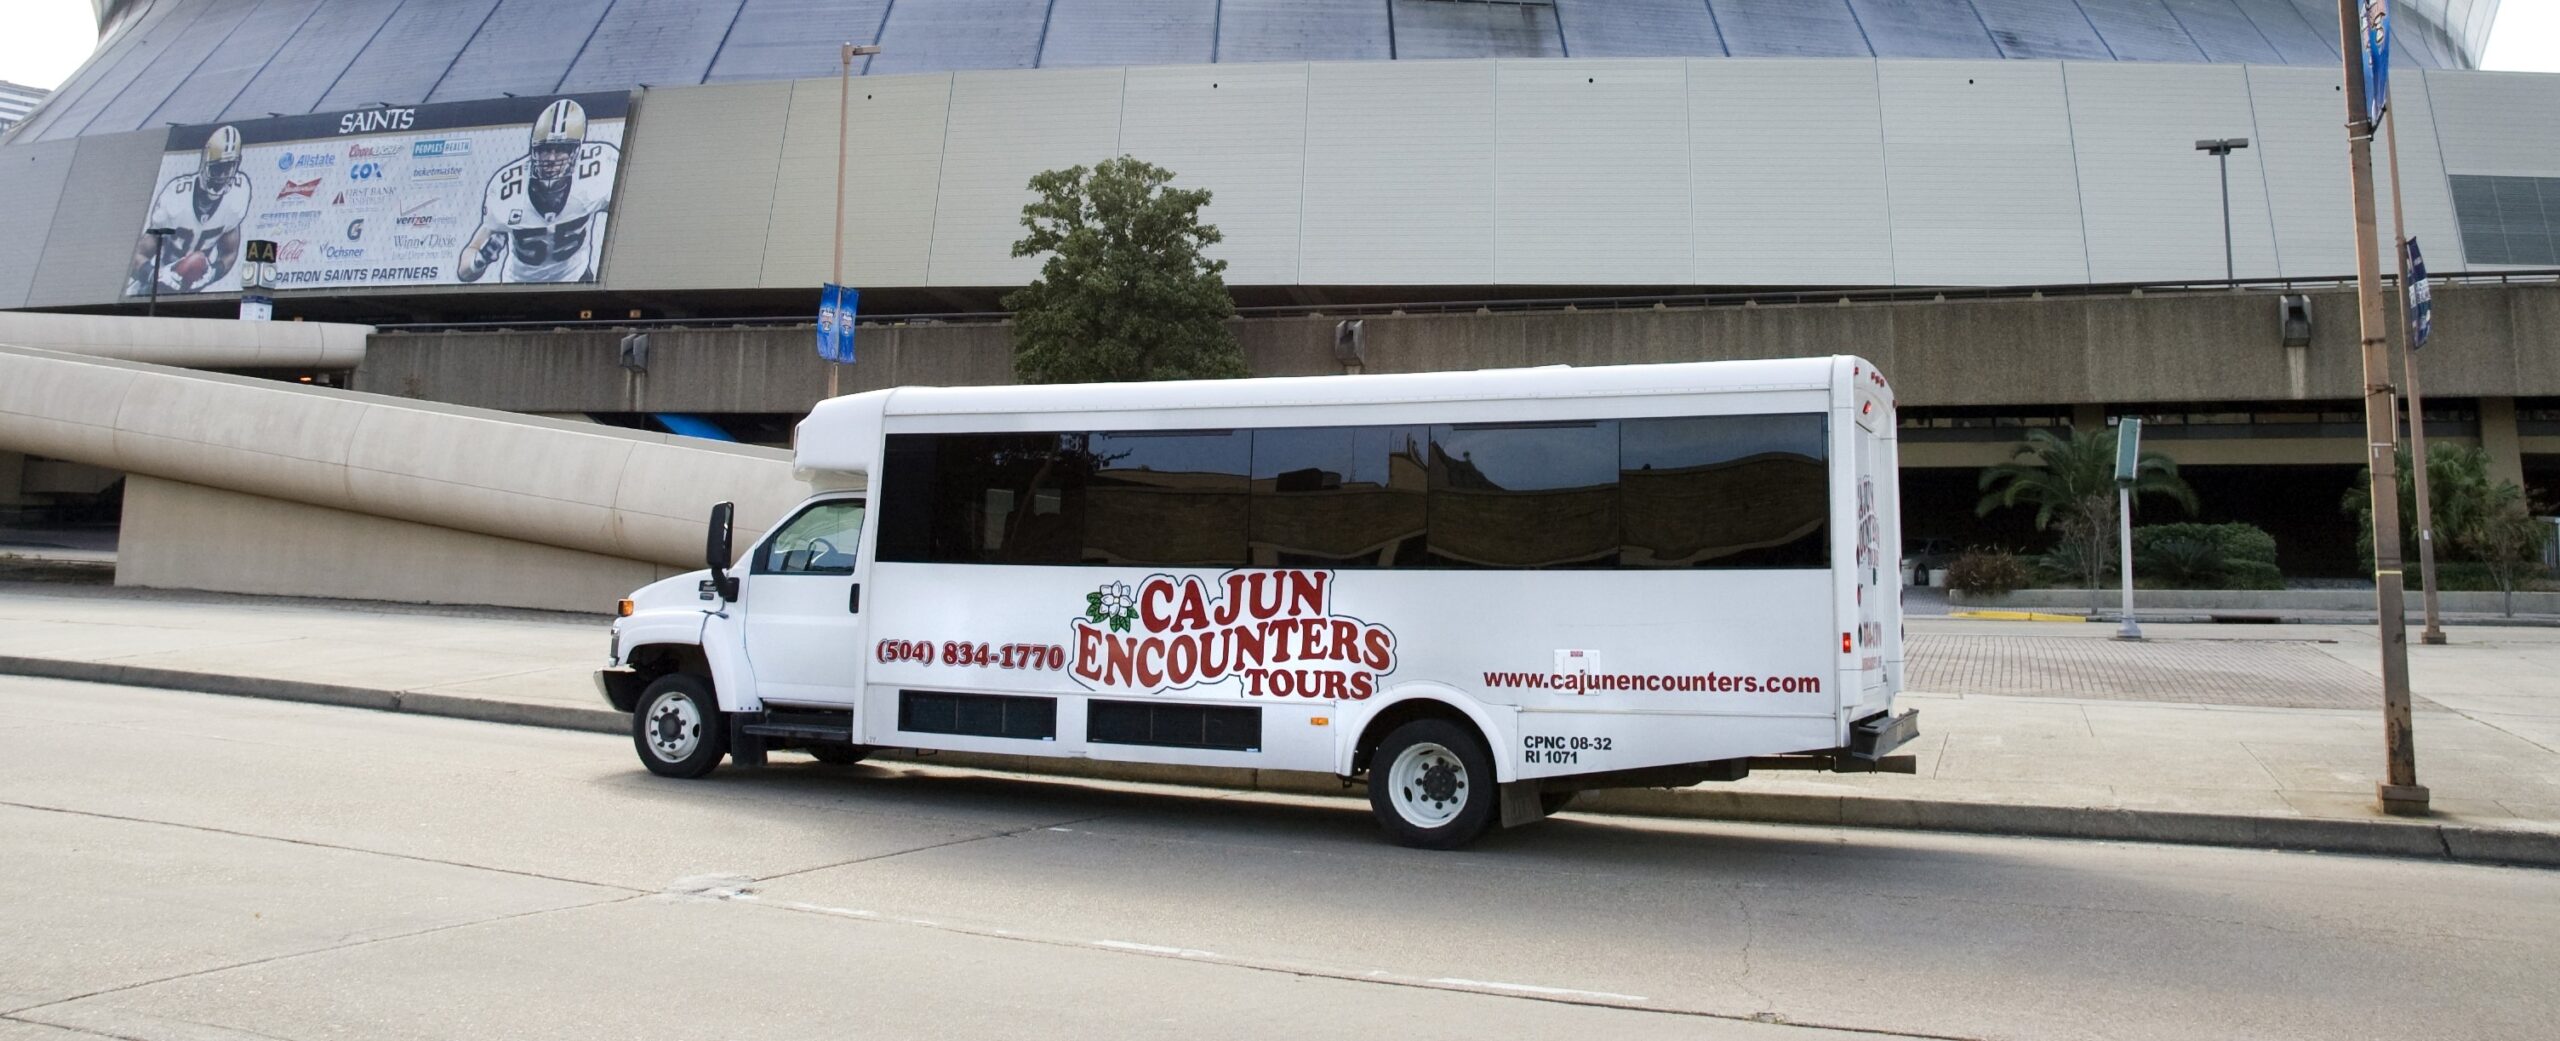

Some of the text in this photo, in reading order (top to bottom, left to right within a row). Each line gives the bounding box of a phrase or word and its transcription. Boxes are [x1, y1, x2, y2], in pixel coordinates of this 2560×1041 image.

[338, 108, 416, 134] SAINTS
[414, 142, 444, 154] PEOPLES
[294, 152, 336, 169] Allstate
[350, 162, 384, 180] COX
[396, 213, 433, 226] verizon
[326, 246, 365, 258] Ochsner
[276, 266, 438, 282] PATRON SAINTS PARTNERS
[1138, 569, 1328, 633] CAJUN
[876, 639, 1066, 671] (504) 834-1770
[1074, 618, 1392, 688] ENCOUNTERS
[1244, 668, 1374, 701] TOURS
[1483, 669, 1821, 695] www.cajunencounters.com
[1524, 736, 1612, 751] CPNC 08-32
[1525, 750, 1578, 764] RI 1071
